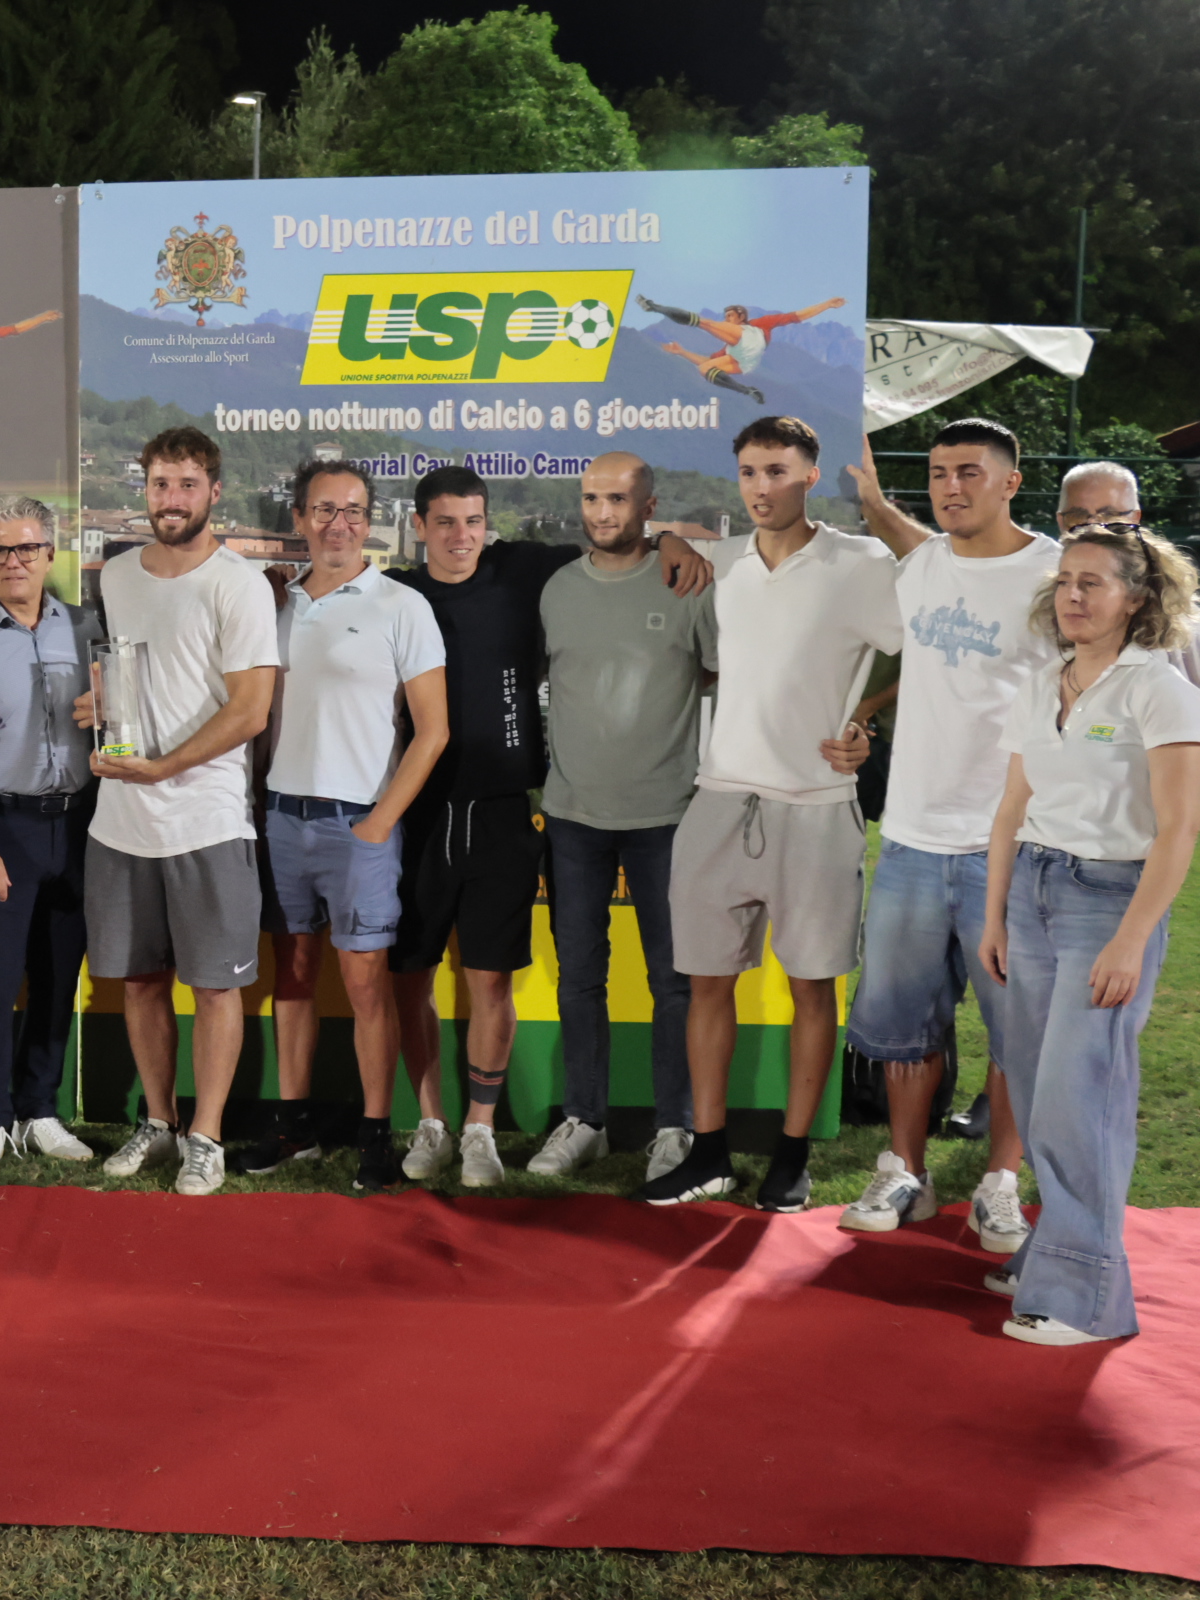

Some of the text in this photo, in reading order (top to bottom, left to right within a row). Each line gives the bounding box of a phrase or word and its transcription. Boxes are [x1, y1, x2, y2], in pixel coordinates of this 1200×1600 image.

[273, 207, 661, 253] Polpenazze del Garda
[123, 332, 275, 349] Comune di Polpenazze del Garda
[149, 350, 250, 366] Assessorato allo Sport
[340, 374, 373, 382] UNIONE
[375, 373, 414, 381] SPORTIVA
[214, 396, 719, 437] torneo notturno di Calcio a 6 giocatori
[350, 453, 406, 476] orial
[462, 452, 527, 477] Attilio
[533, 452, 591, 477] Camo
